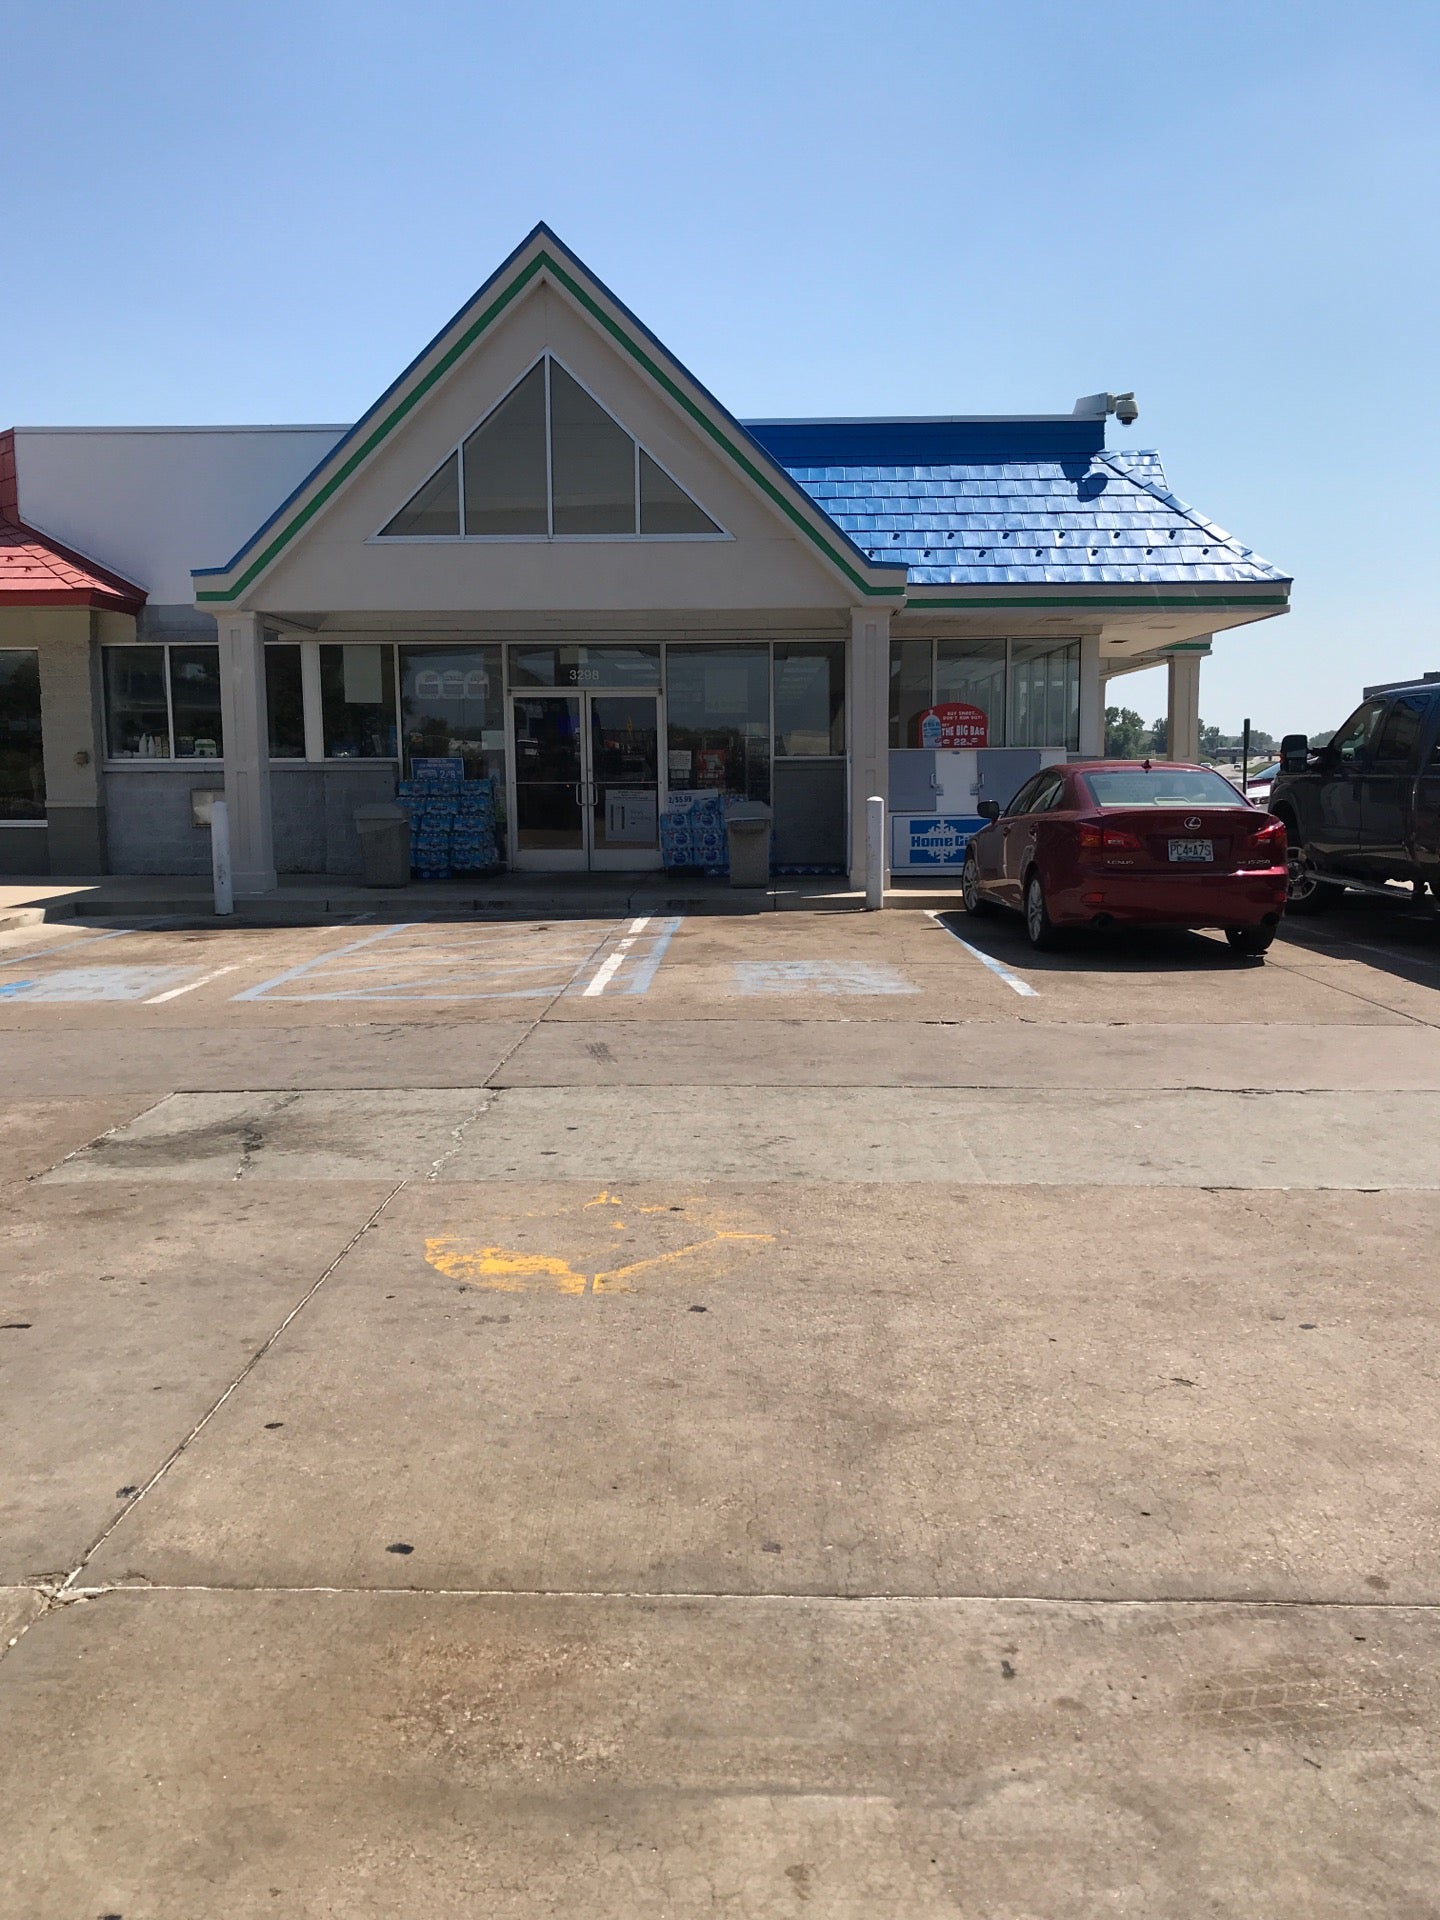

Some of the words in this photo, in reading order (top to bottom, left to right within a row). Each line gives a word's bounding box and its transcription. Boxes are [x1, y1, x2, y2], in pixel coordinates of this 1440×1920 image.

[569, 669, 600, 680] 3298
[941, 726, 954, 736] THE
[956, 725, 969, 736] BIG
[970, 725, 985, 736] BAG
[911, 835, 953, 847] Home
